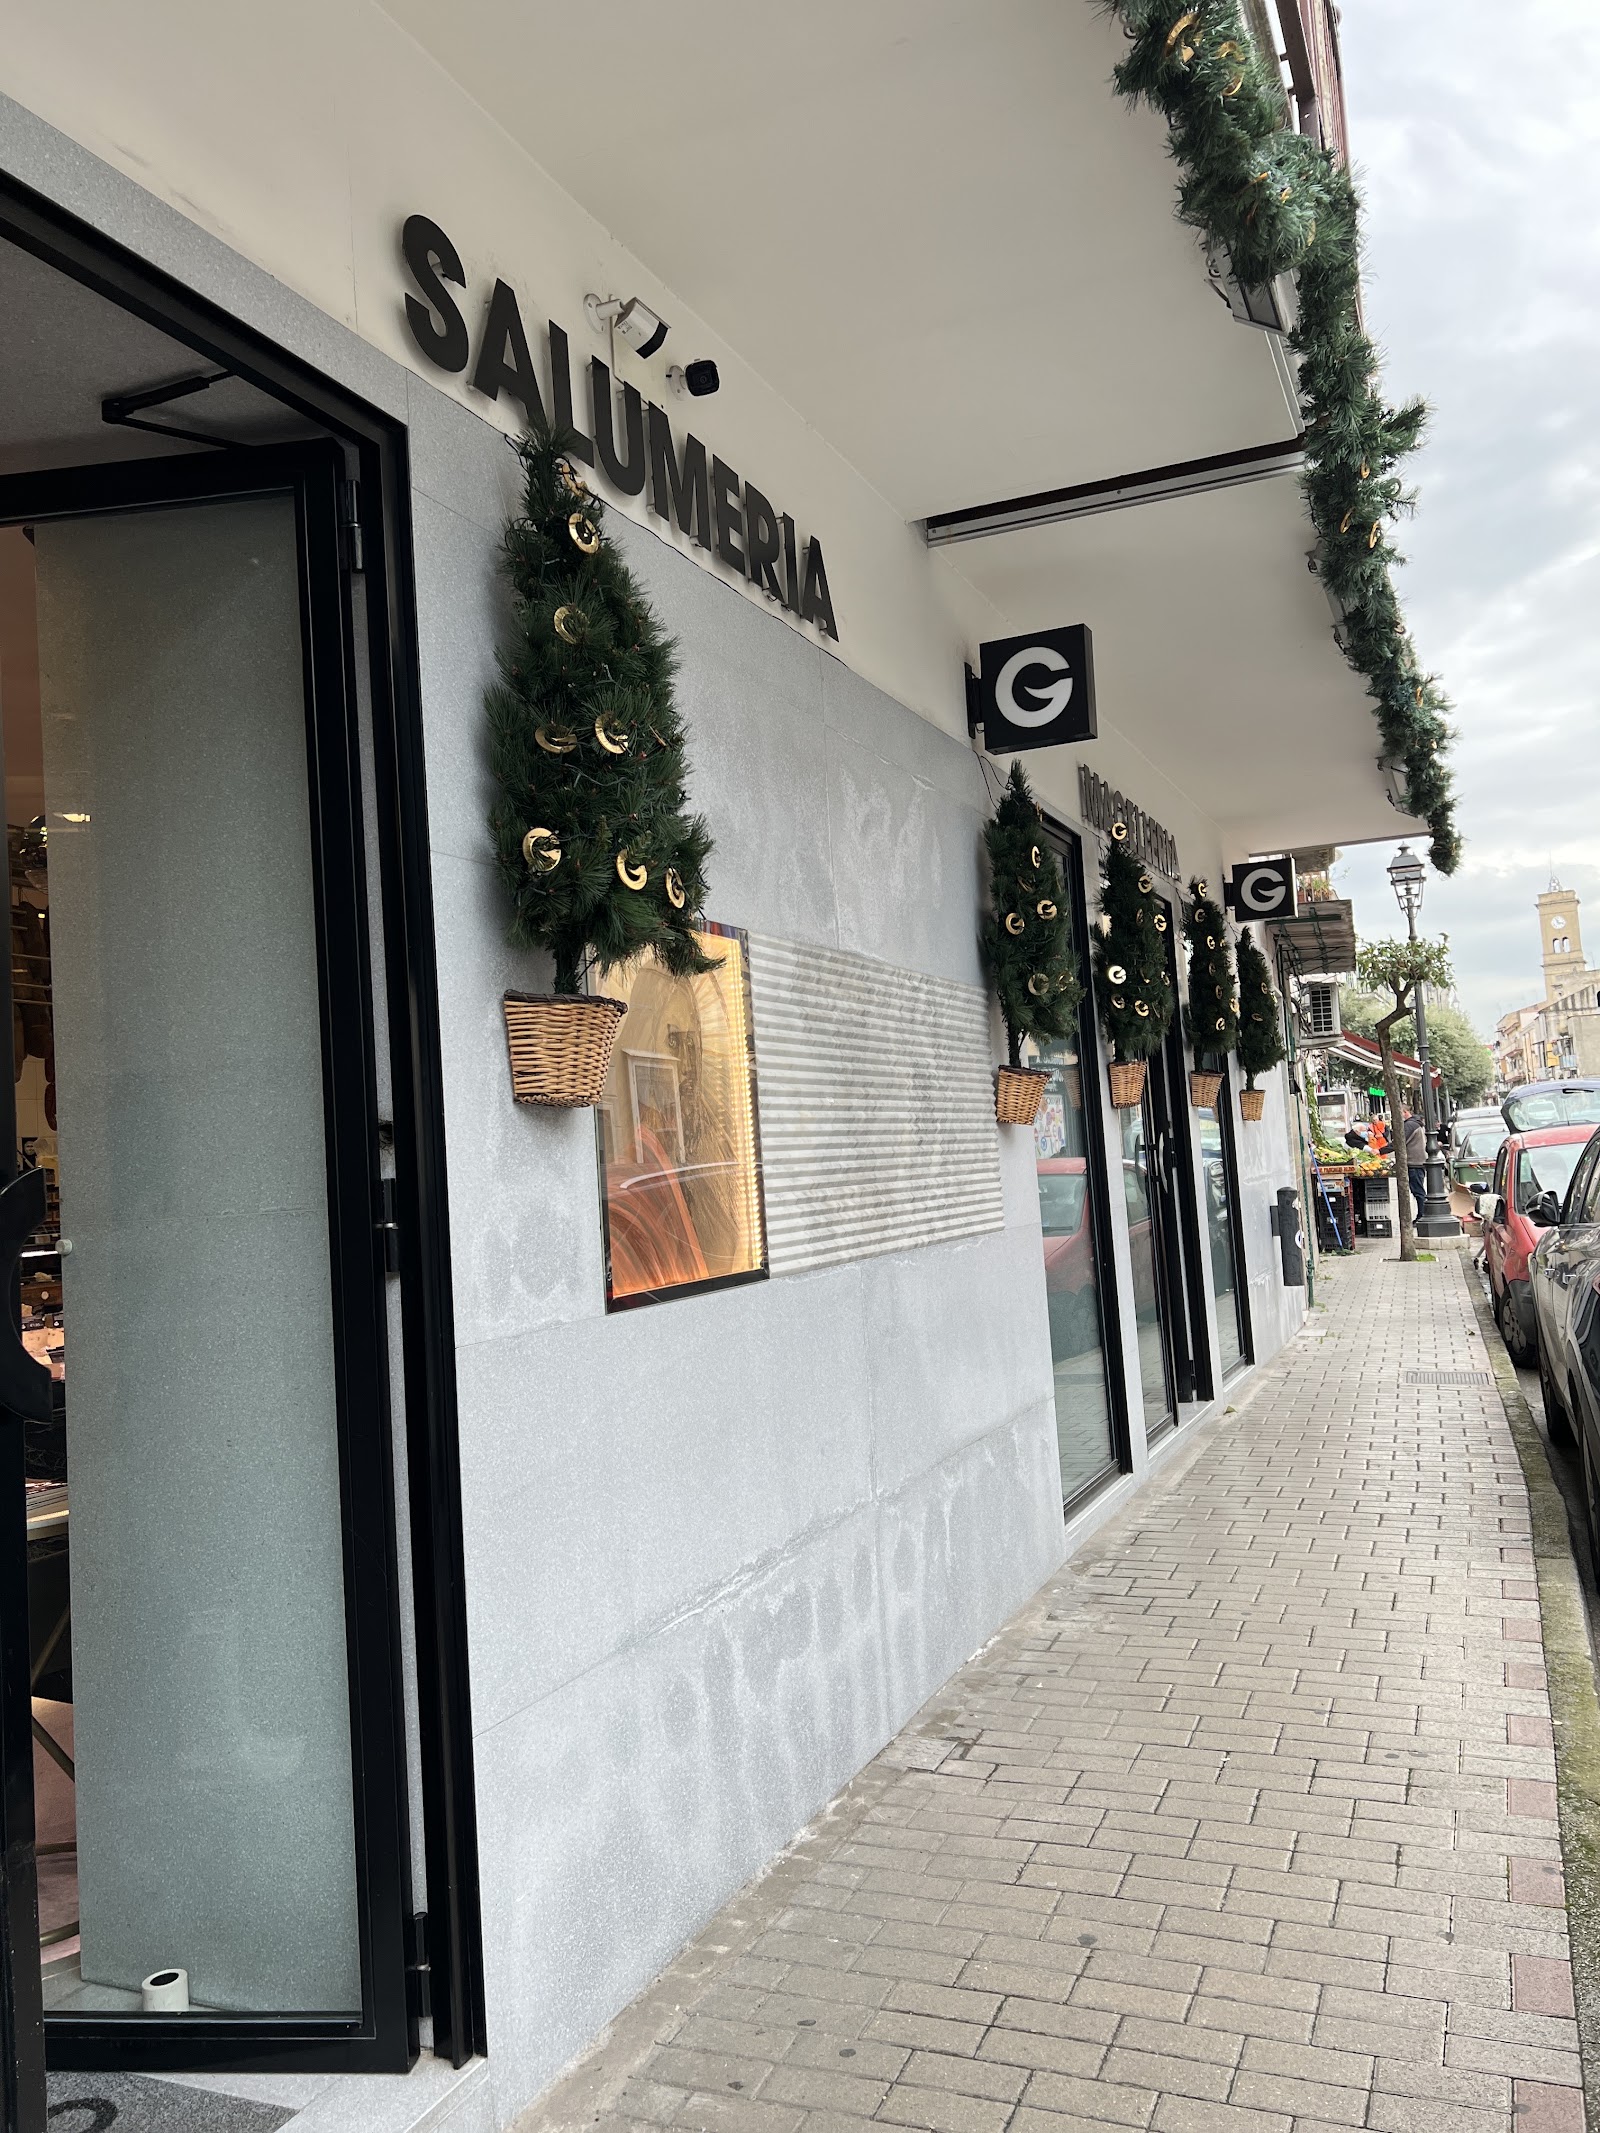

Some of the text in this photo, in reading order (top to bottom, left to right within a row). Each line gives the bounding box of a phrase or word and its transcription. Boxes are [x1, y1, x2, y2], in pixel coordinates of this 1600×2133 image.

[402, 213, 839, 643] SALUMERIA
[995, 646, 1074, 728] G
[1240, 867, 1287, 912] G
